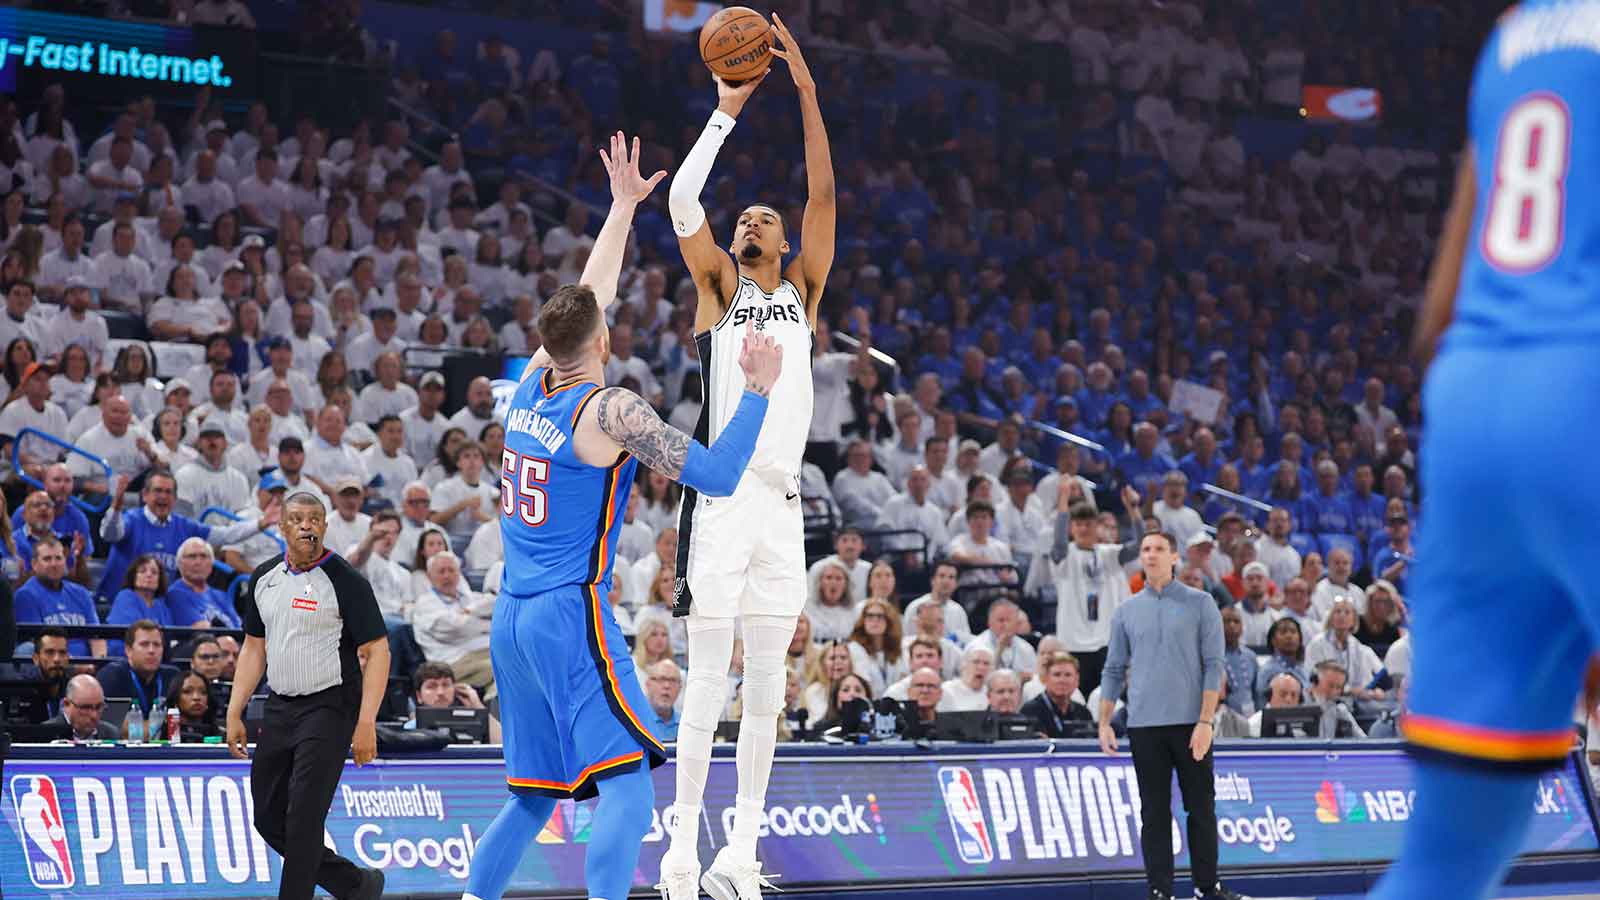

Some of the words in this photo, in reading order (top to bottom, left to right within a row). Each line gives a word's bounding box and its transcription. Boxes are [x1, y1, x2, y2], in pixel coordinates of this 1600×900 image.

[98, 43, 233, 88] Internet.
[1480, 90, 1573, 276] 8
[733, 303, 800, 331] SPURS
[501, 446, 551, 528] 55
[341, 784, 424, 817] Presented
[420, 784, 445, 821] by
[982, 765, 1182, 861] PLAYOF
[1216, 804, 1296, 853] oogle
[72, 775, 338, 886] PLAYO
[353, 823, 482, 879] Googl
[34, 861, 59, 881] NBA
